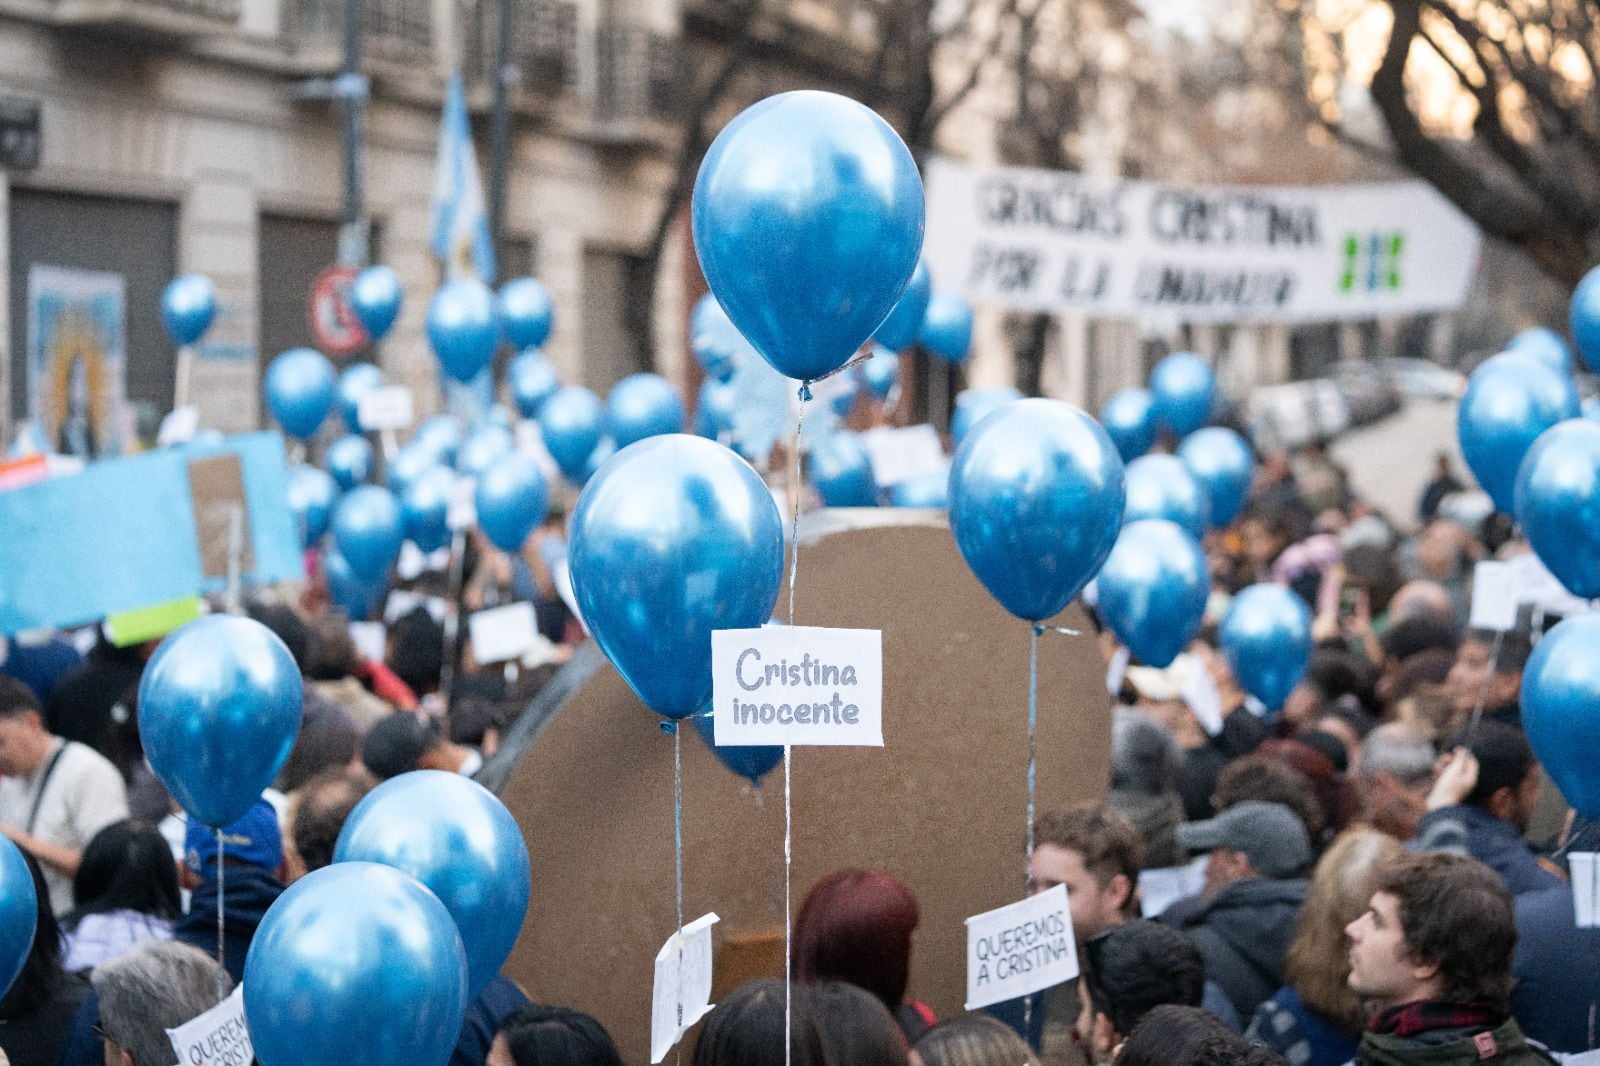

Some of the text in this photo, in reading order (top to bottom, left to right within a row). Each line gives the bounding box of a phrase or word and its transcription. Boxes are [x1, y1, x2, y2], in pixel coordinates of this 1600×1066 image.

[1149, 184, 1324, 249] CRISTINA
[735, 647, 858, 691] Cristina
[732, 692, 860, 725] inocente
[976, 910, 1064, 962] QUEREMOS
[976, 937, 1068, 986] A CRISTINA
